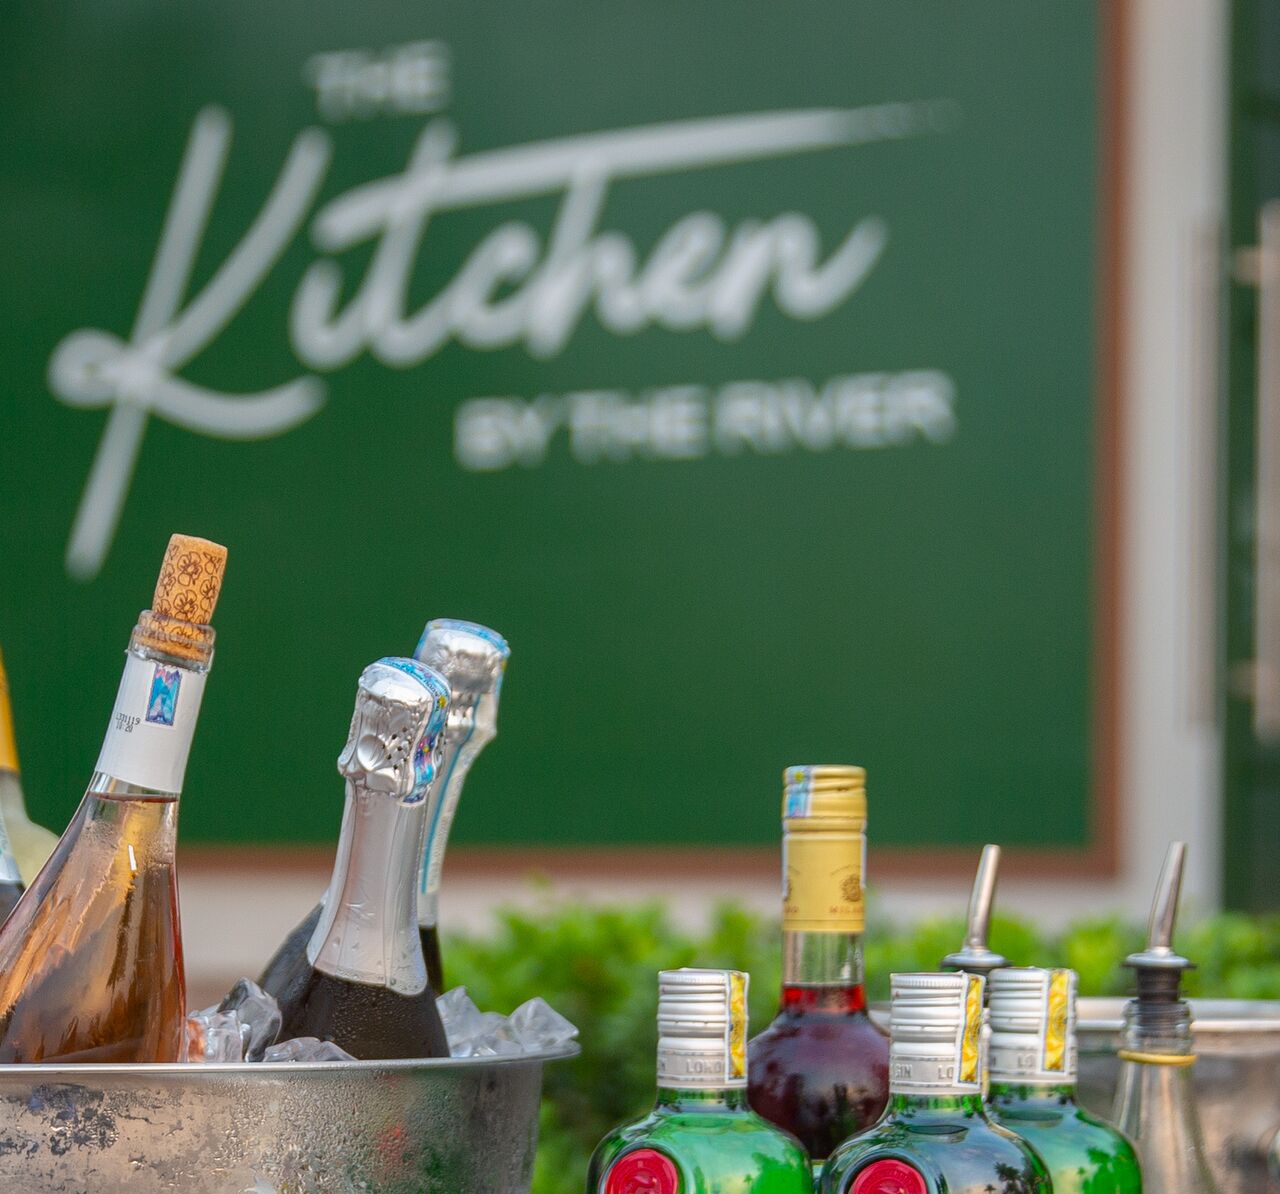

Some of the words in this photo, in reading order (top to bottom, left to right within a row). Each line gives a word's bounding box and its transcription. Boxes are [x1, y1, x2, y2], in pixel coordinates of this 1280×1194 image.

[310, 38, 451, 114] THE
[47, 100, 960, 584] Kitchen
[454, 396, 553, 472] BY
[570, 382, 708, 463] THE
[713, 368, 959, 453] RIVER
